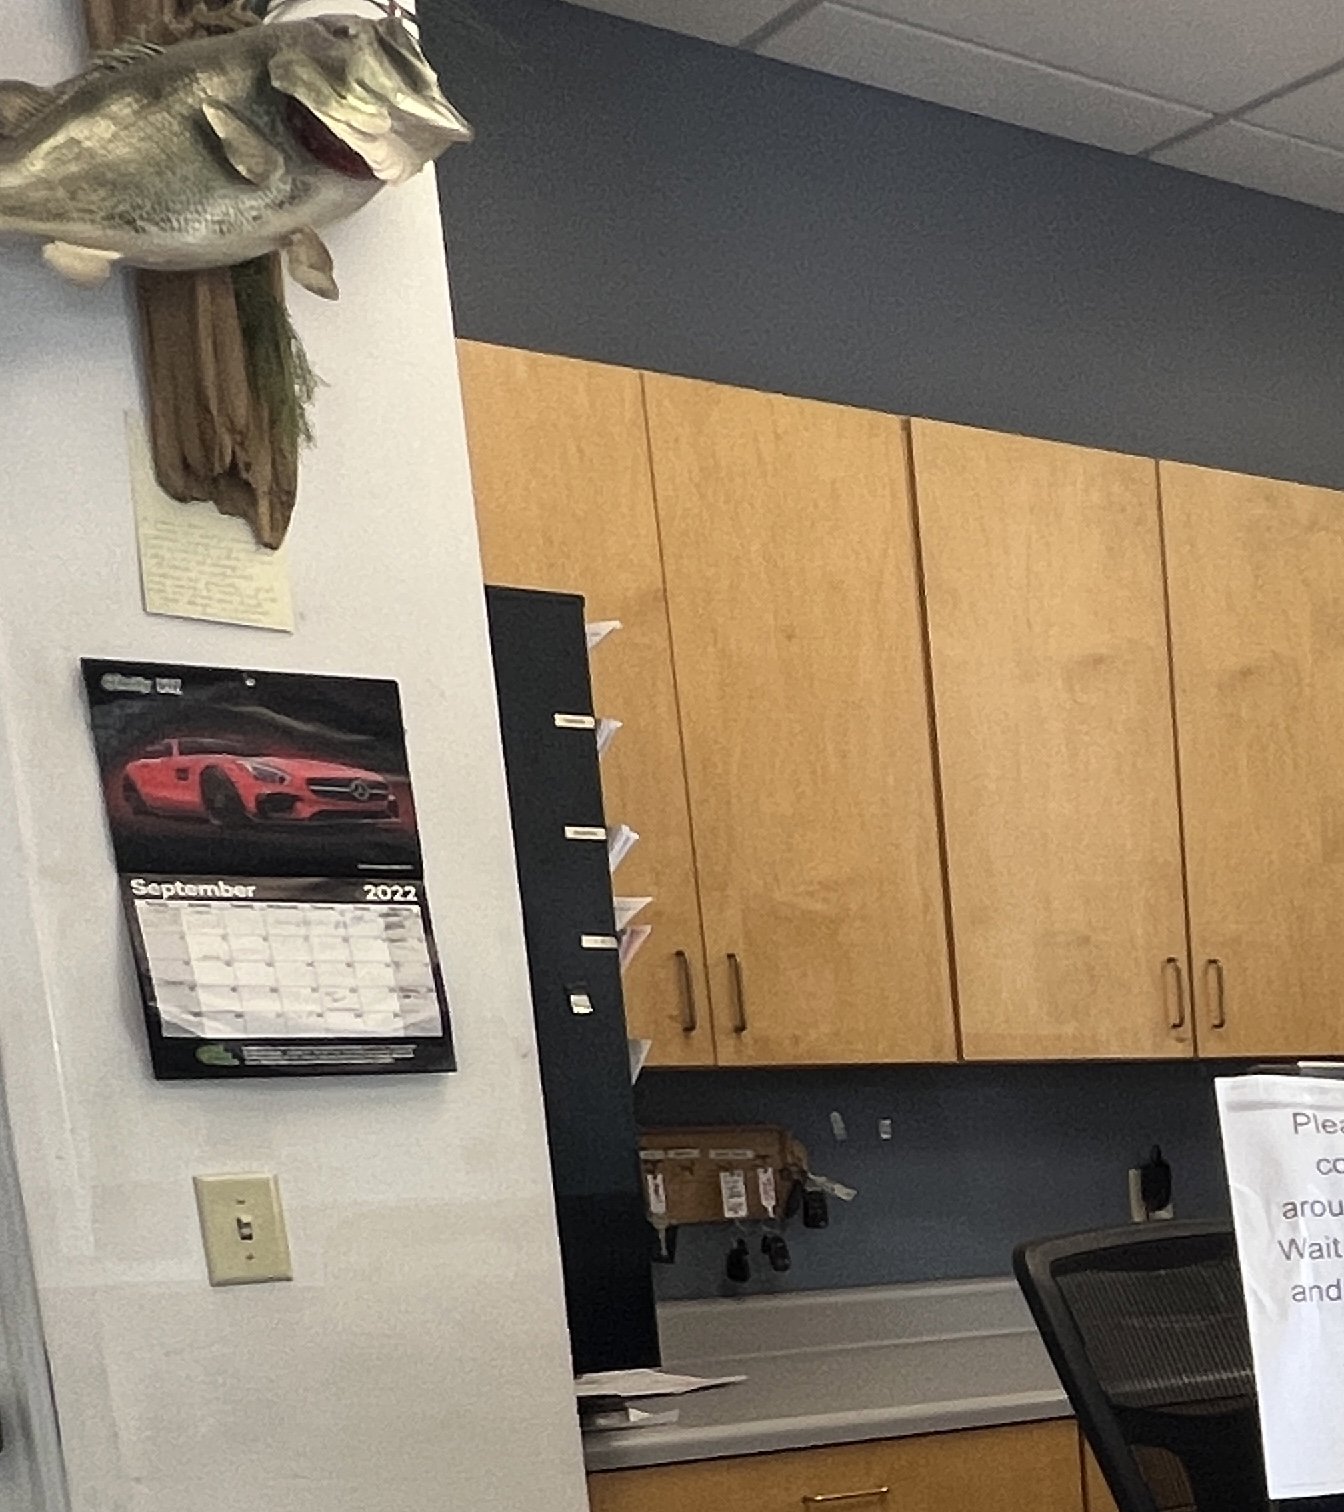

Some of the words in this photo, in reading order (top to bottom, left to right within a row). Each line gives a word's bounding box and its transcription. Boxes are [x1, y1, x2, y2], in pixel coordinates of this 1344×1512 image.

[131, 878, 257, 900] September
[363, 883, 418, 902] 2022
[1277, 1234, 1341, 1263] Wait
[1290, 1278, 1342, 1304] and
